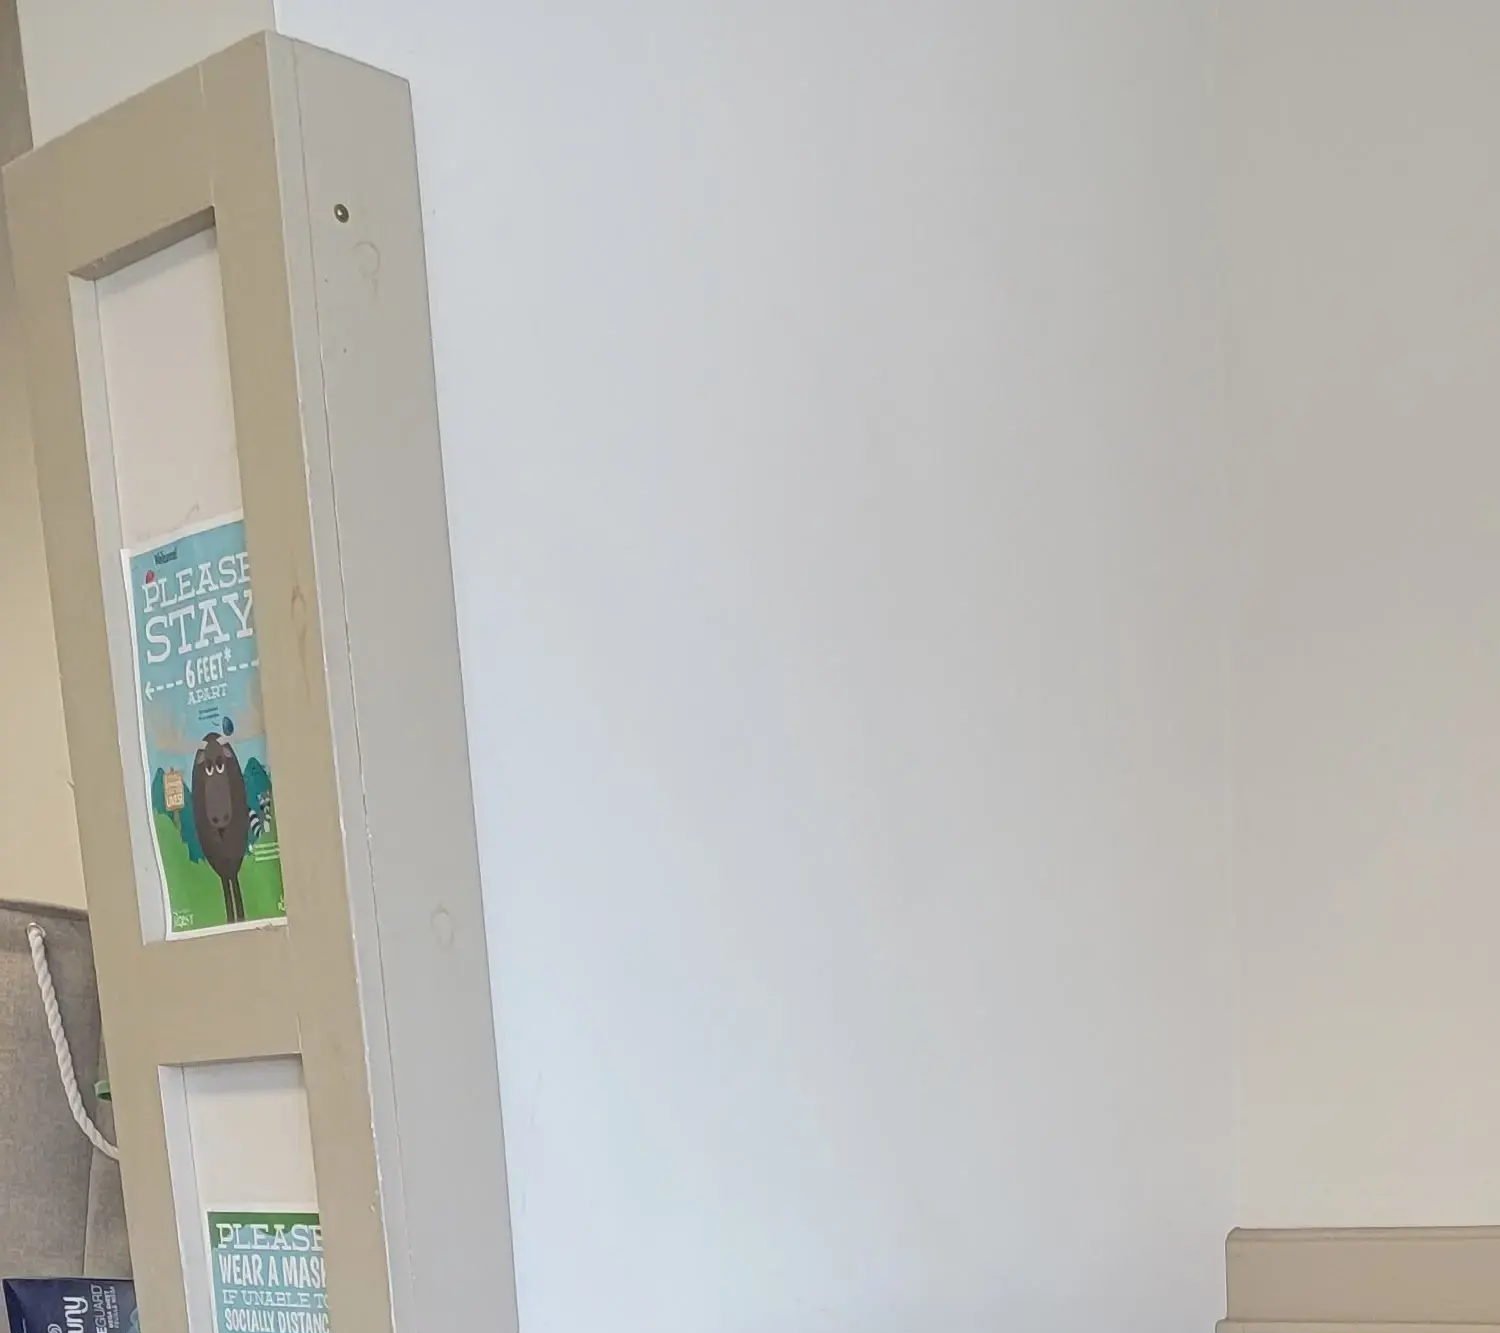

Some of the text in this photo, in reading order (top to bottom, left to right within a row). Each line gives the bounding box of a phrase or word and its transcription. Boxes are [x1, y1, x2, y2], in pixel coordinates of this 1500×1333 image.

[142, 552, 252, 613] PLEASE
[146, 589, 254, 664] STAY
[185, 659, 196, 689] 6
[187, 683, 228, 705] APART
[218, 1254, 264, 1287] WEAR
[268, 1255, 279, 1287] A
[222, 1290, 238, 1305] IF
[241, 1290, 311, 1308] UNABLE
[225, 1308, 275, 1333] SOCIALLY
